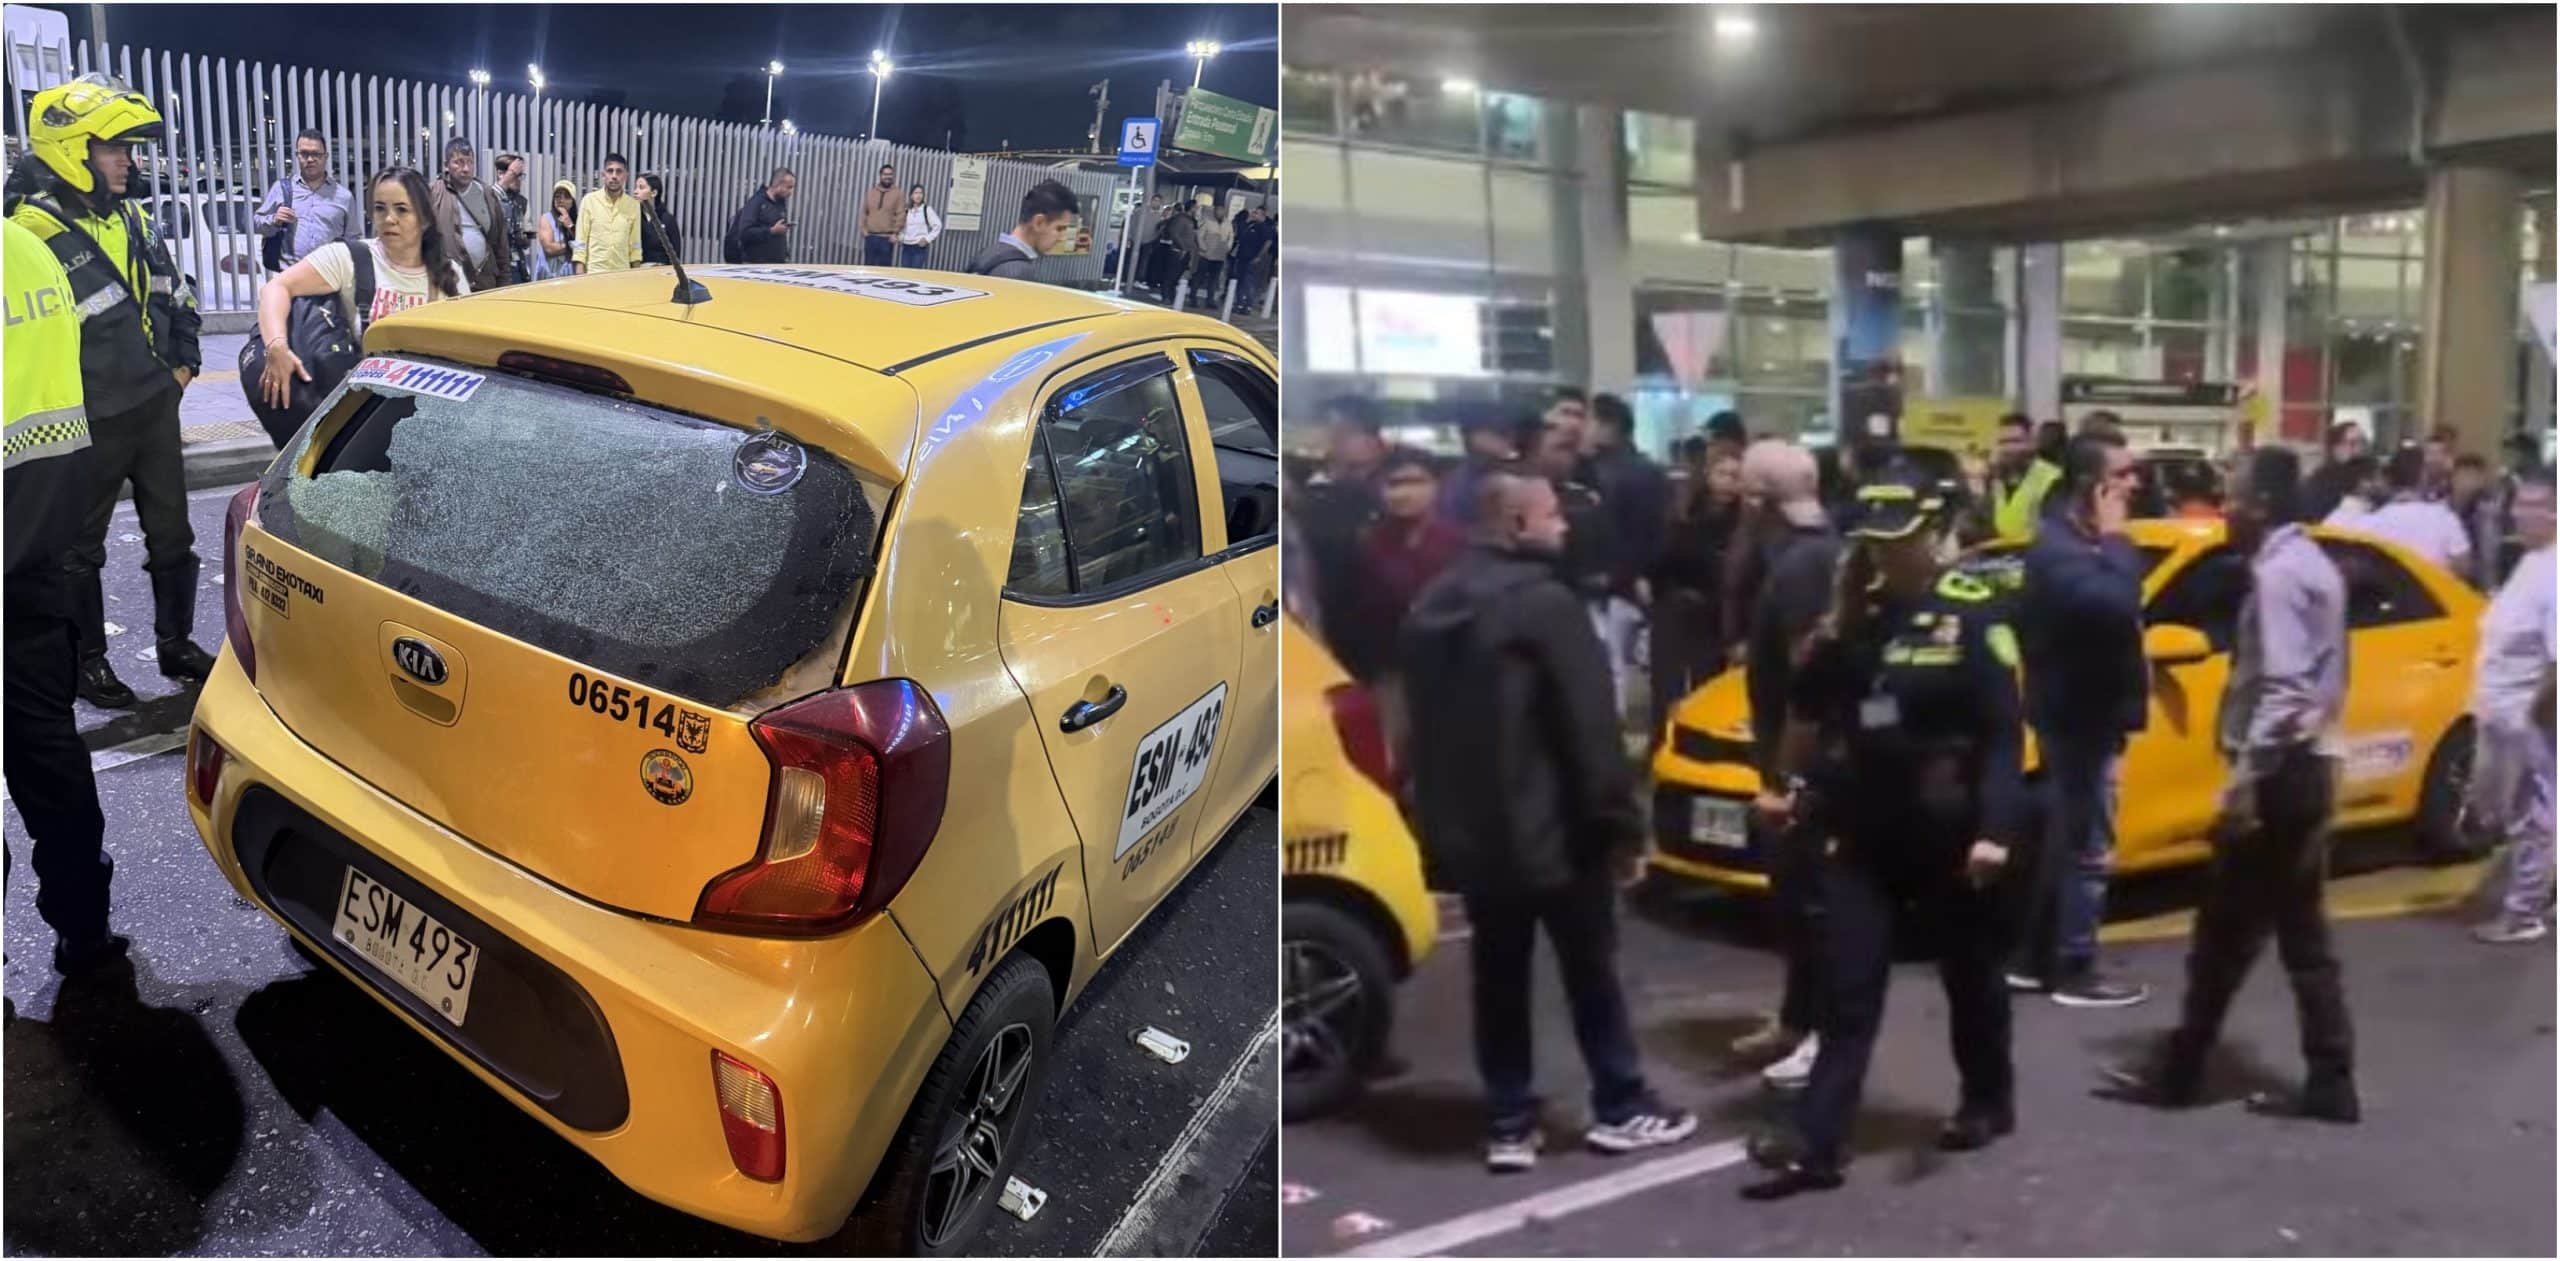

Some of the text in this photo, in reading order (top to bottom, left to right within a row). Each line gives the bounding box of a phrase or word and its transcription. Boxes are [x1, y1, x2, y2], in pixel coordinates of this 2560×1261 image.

[276, 565, 325, 605] EKOTAXI
[399, 643, 438, 681] KIA
[568, 672, 676, 739] 06514
